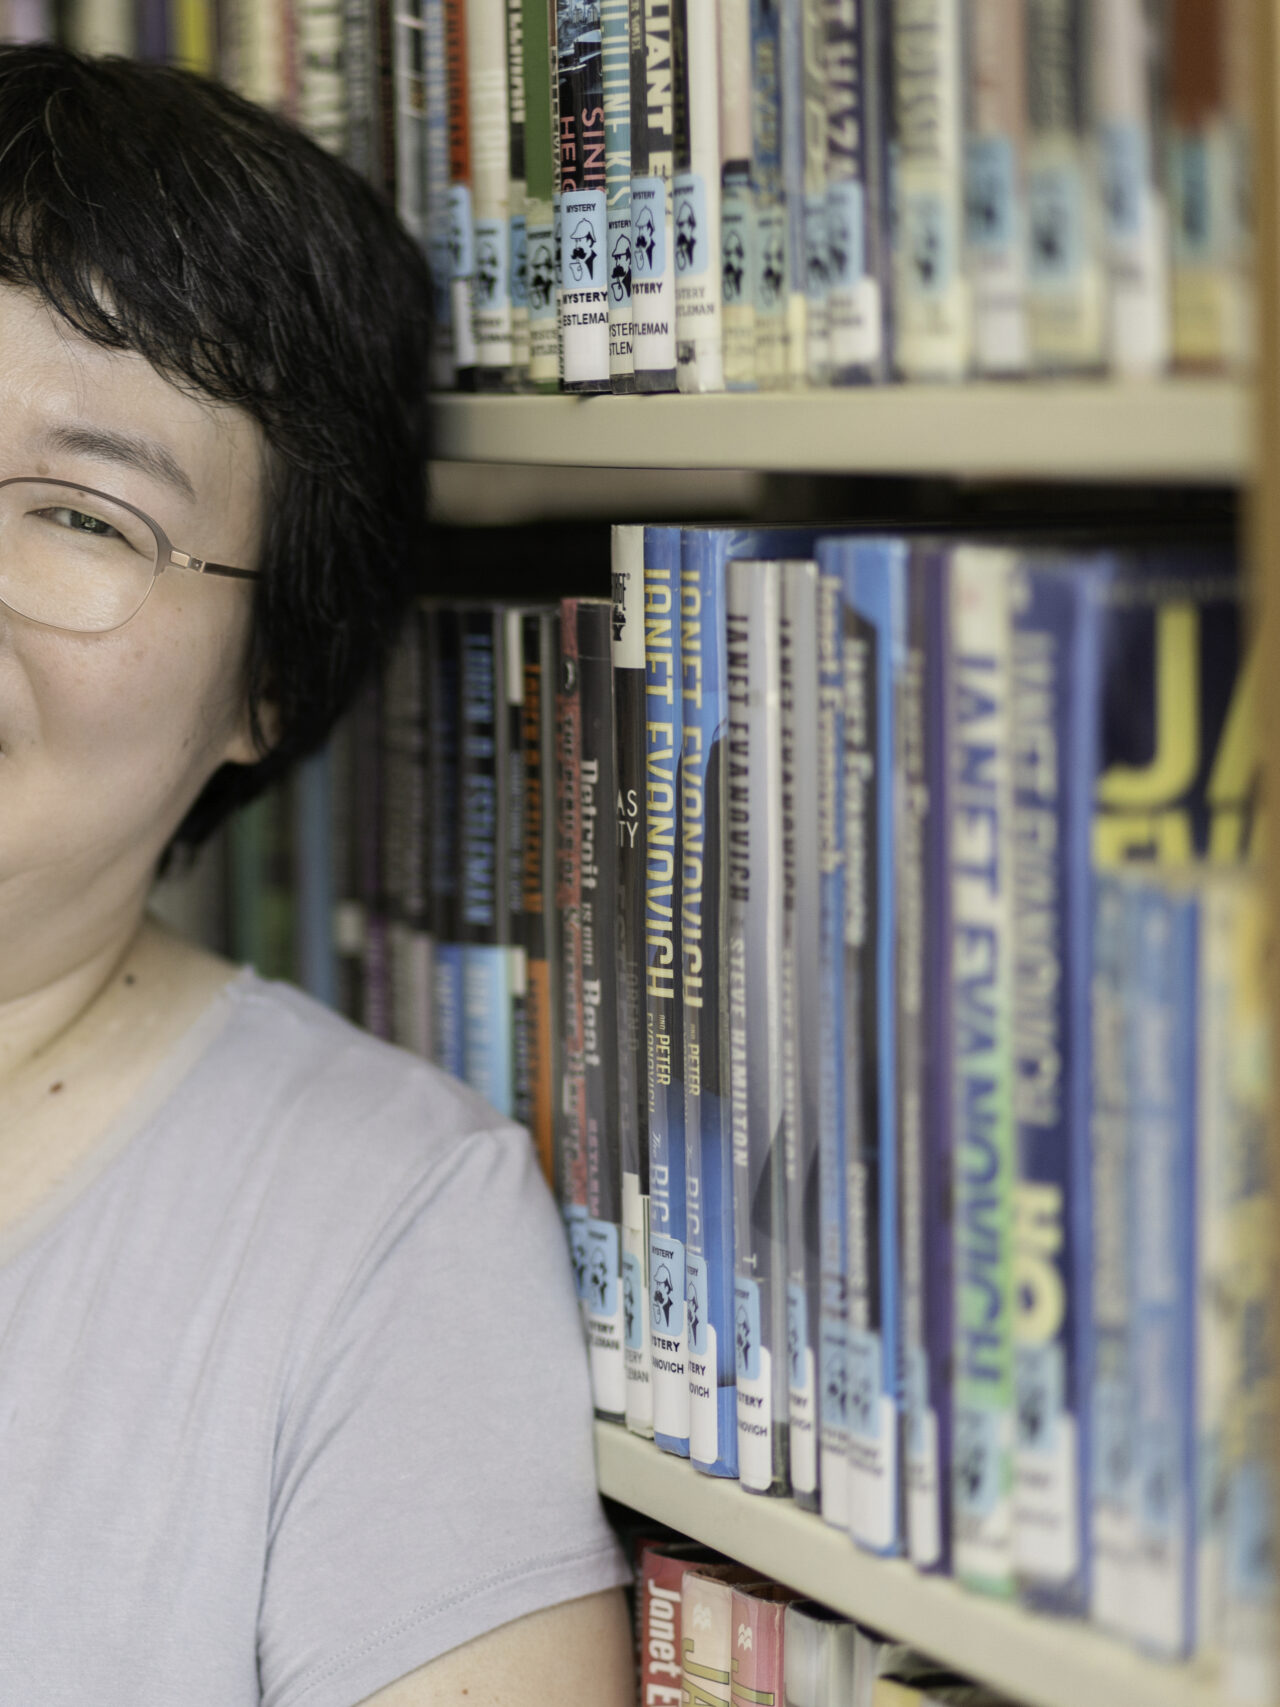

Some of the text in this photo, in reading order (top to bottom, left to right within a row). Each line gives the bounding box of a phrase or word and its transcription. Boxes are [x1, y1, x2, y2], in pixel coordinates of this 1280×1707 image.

[581, 106, 606, 193] SINI
[566, 203, 597, 214] MYSTERY
[562, 291, 609, 305] MYSTERY
[727, 614, 750, 902] JANET EVANOVICH
[645, 721, 674, 999] EVANOVICH
[681, 725, 703, 1008] EVANOVICH
[656, 1033, 671, 1086] PETER
[687, 1043, 701, 1096] PETER
[730, 936, 749, 1168] STEVE HAMILTON
[646, 1579, 682, 1679] Janet
